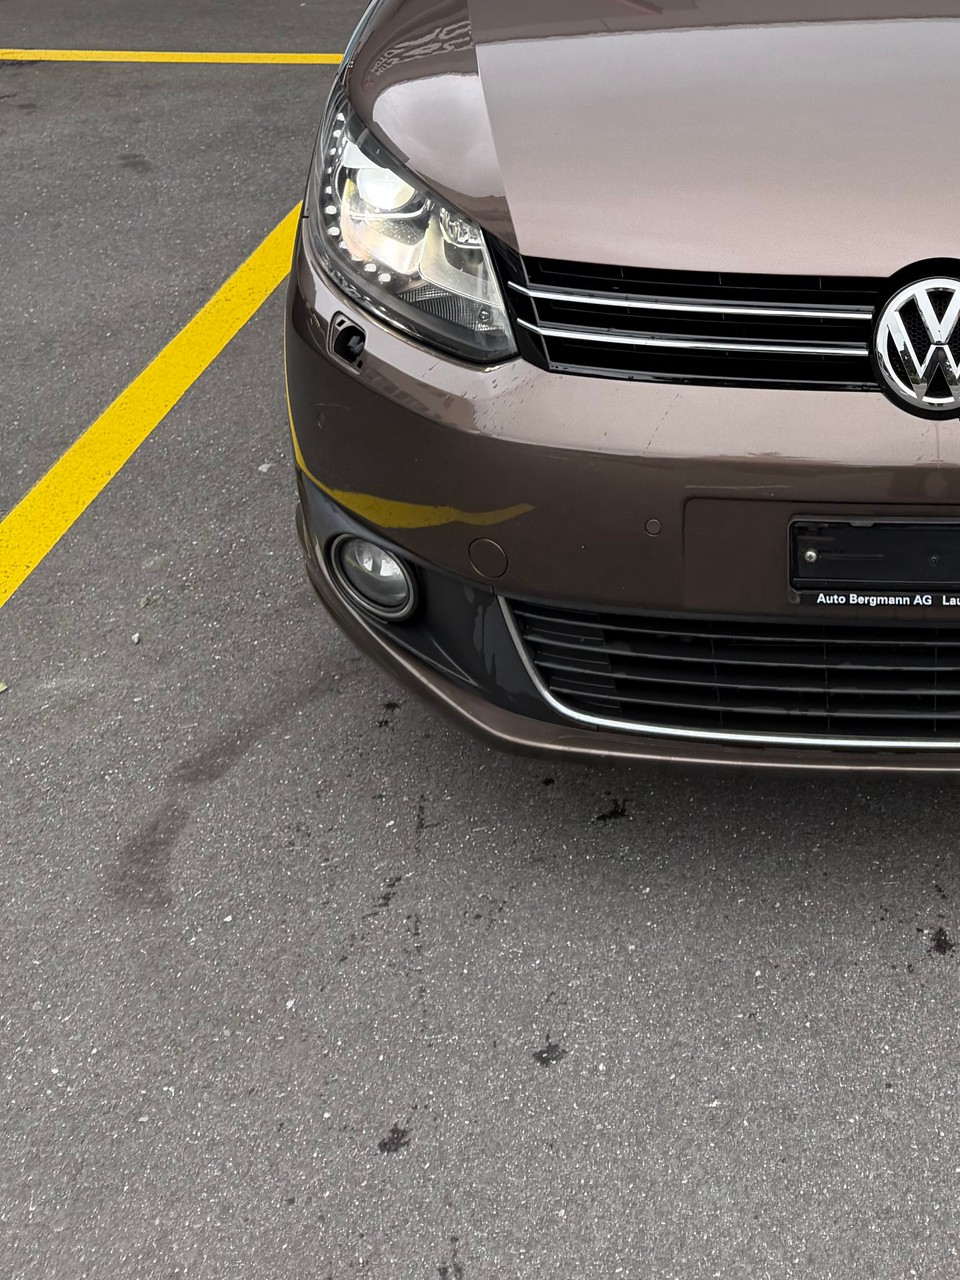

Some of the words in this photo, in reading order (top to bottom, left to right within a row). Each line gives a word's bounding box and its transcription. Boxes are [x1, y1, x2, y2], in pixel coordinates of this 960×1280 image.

[816, 593, 846, 604] Auto
[849, 593, 910, 607] Bergmann
[913, 595, 932, 606] AG
